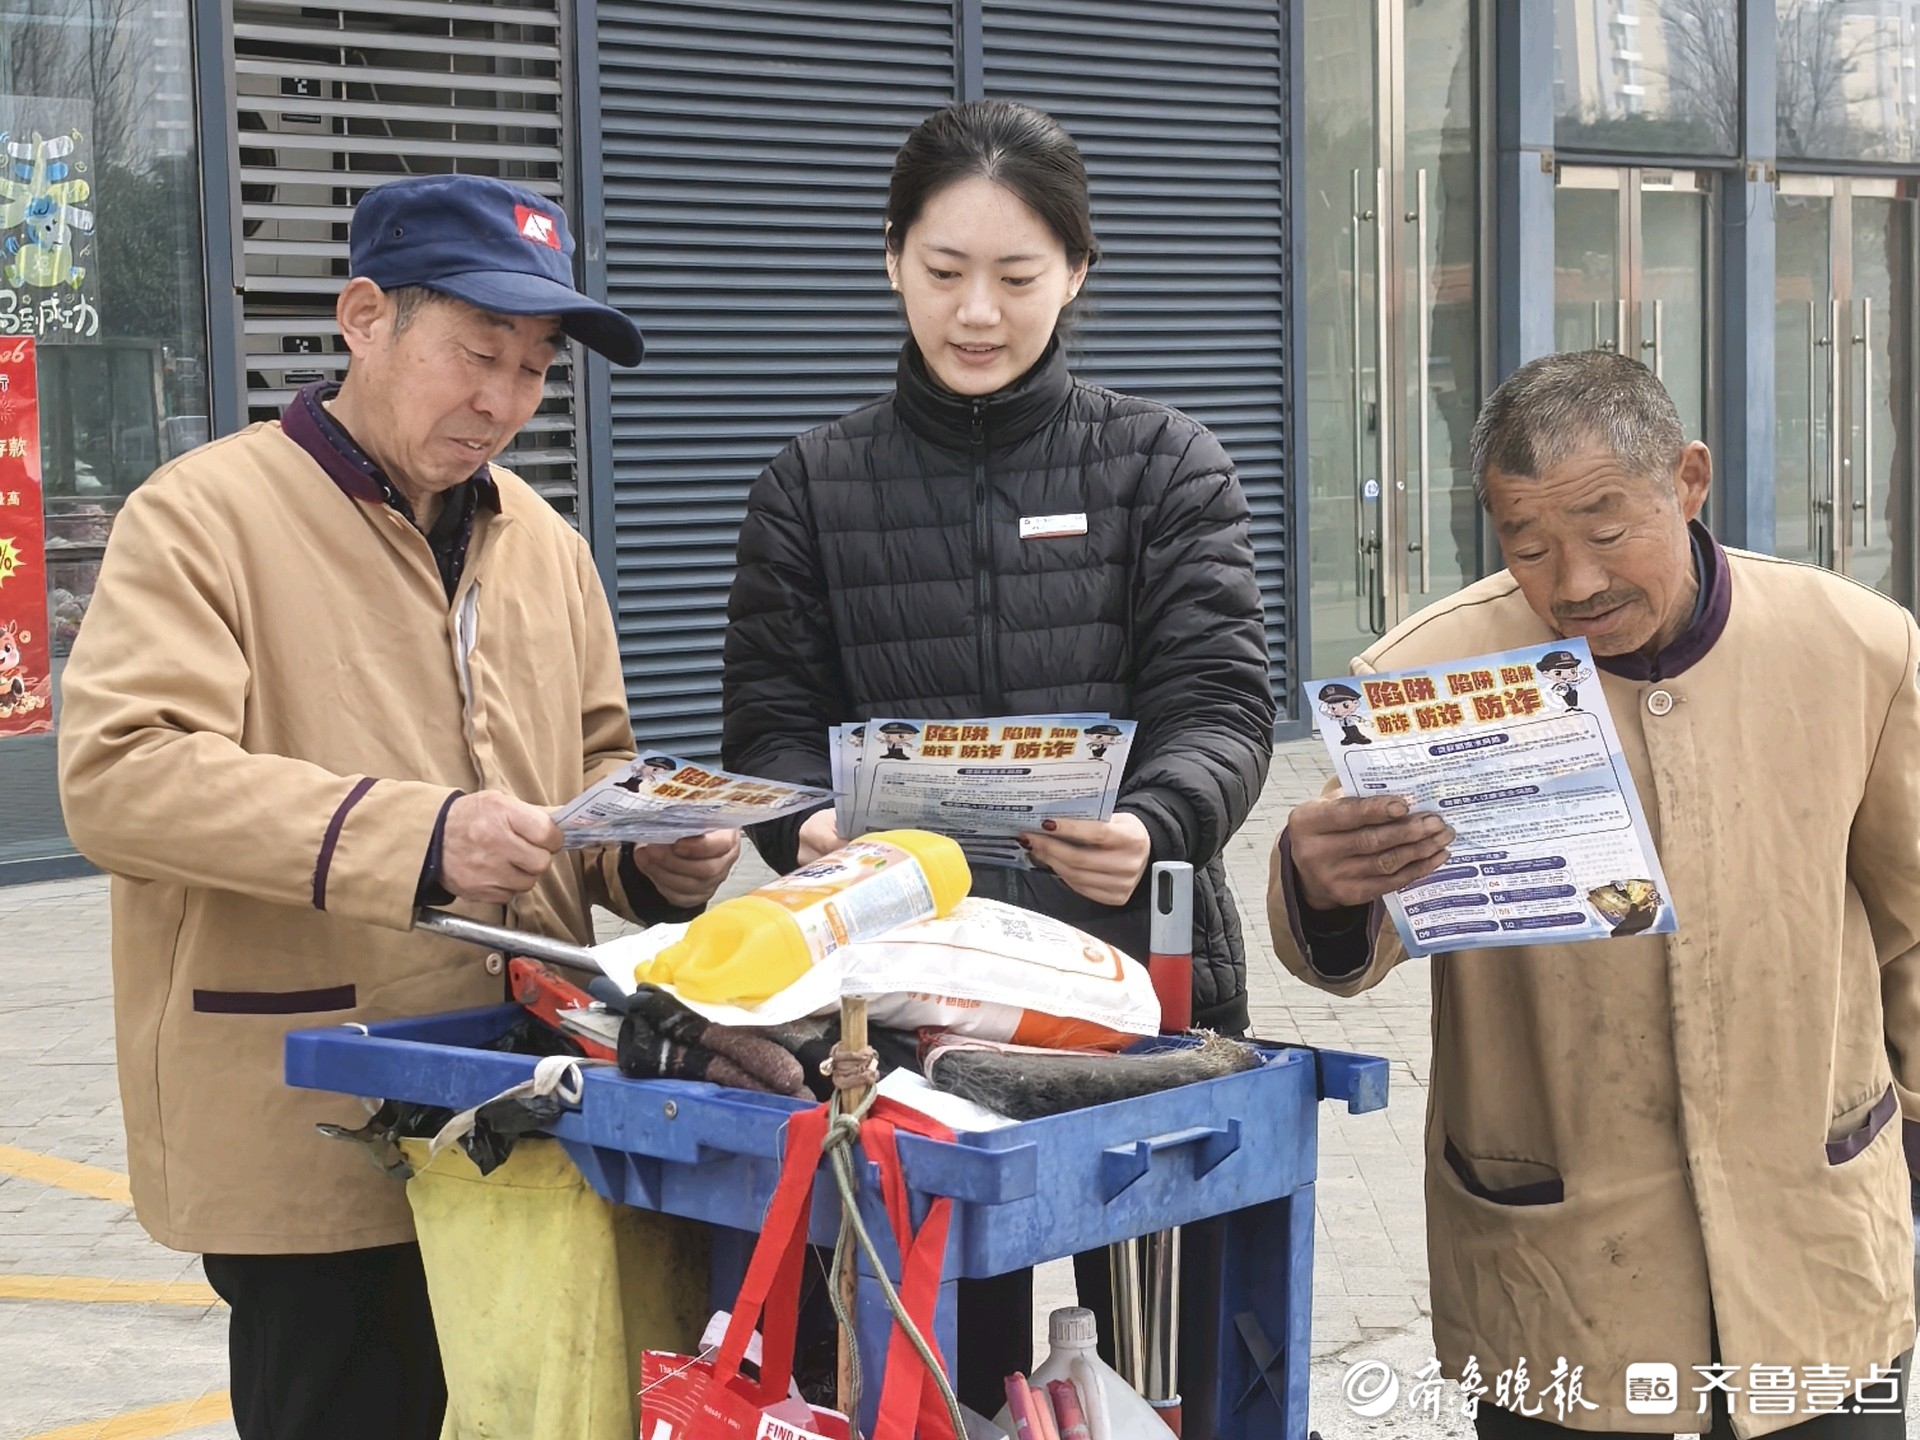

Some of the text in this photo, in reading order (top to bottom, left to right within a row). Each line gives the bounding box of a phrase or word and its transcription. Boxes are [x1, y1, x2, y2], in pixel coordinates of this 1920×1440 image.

[1364, 665, 1534, 710] 陷阱 陷阱 陷阱
[1376, 688, 1541, 734] 防诈 防诈 防诈
[925, 725, 989, 741] 陷阱
[1002, 727, 1042, 740] 陷阱
[923, 741, 1075, 759] 防诈 防诈 防诈
